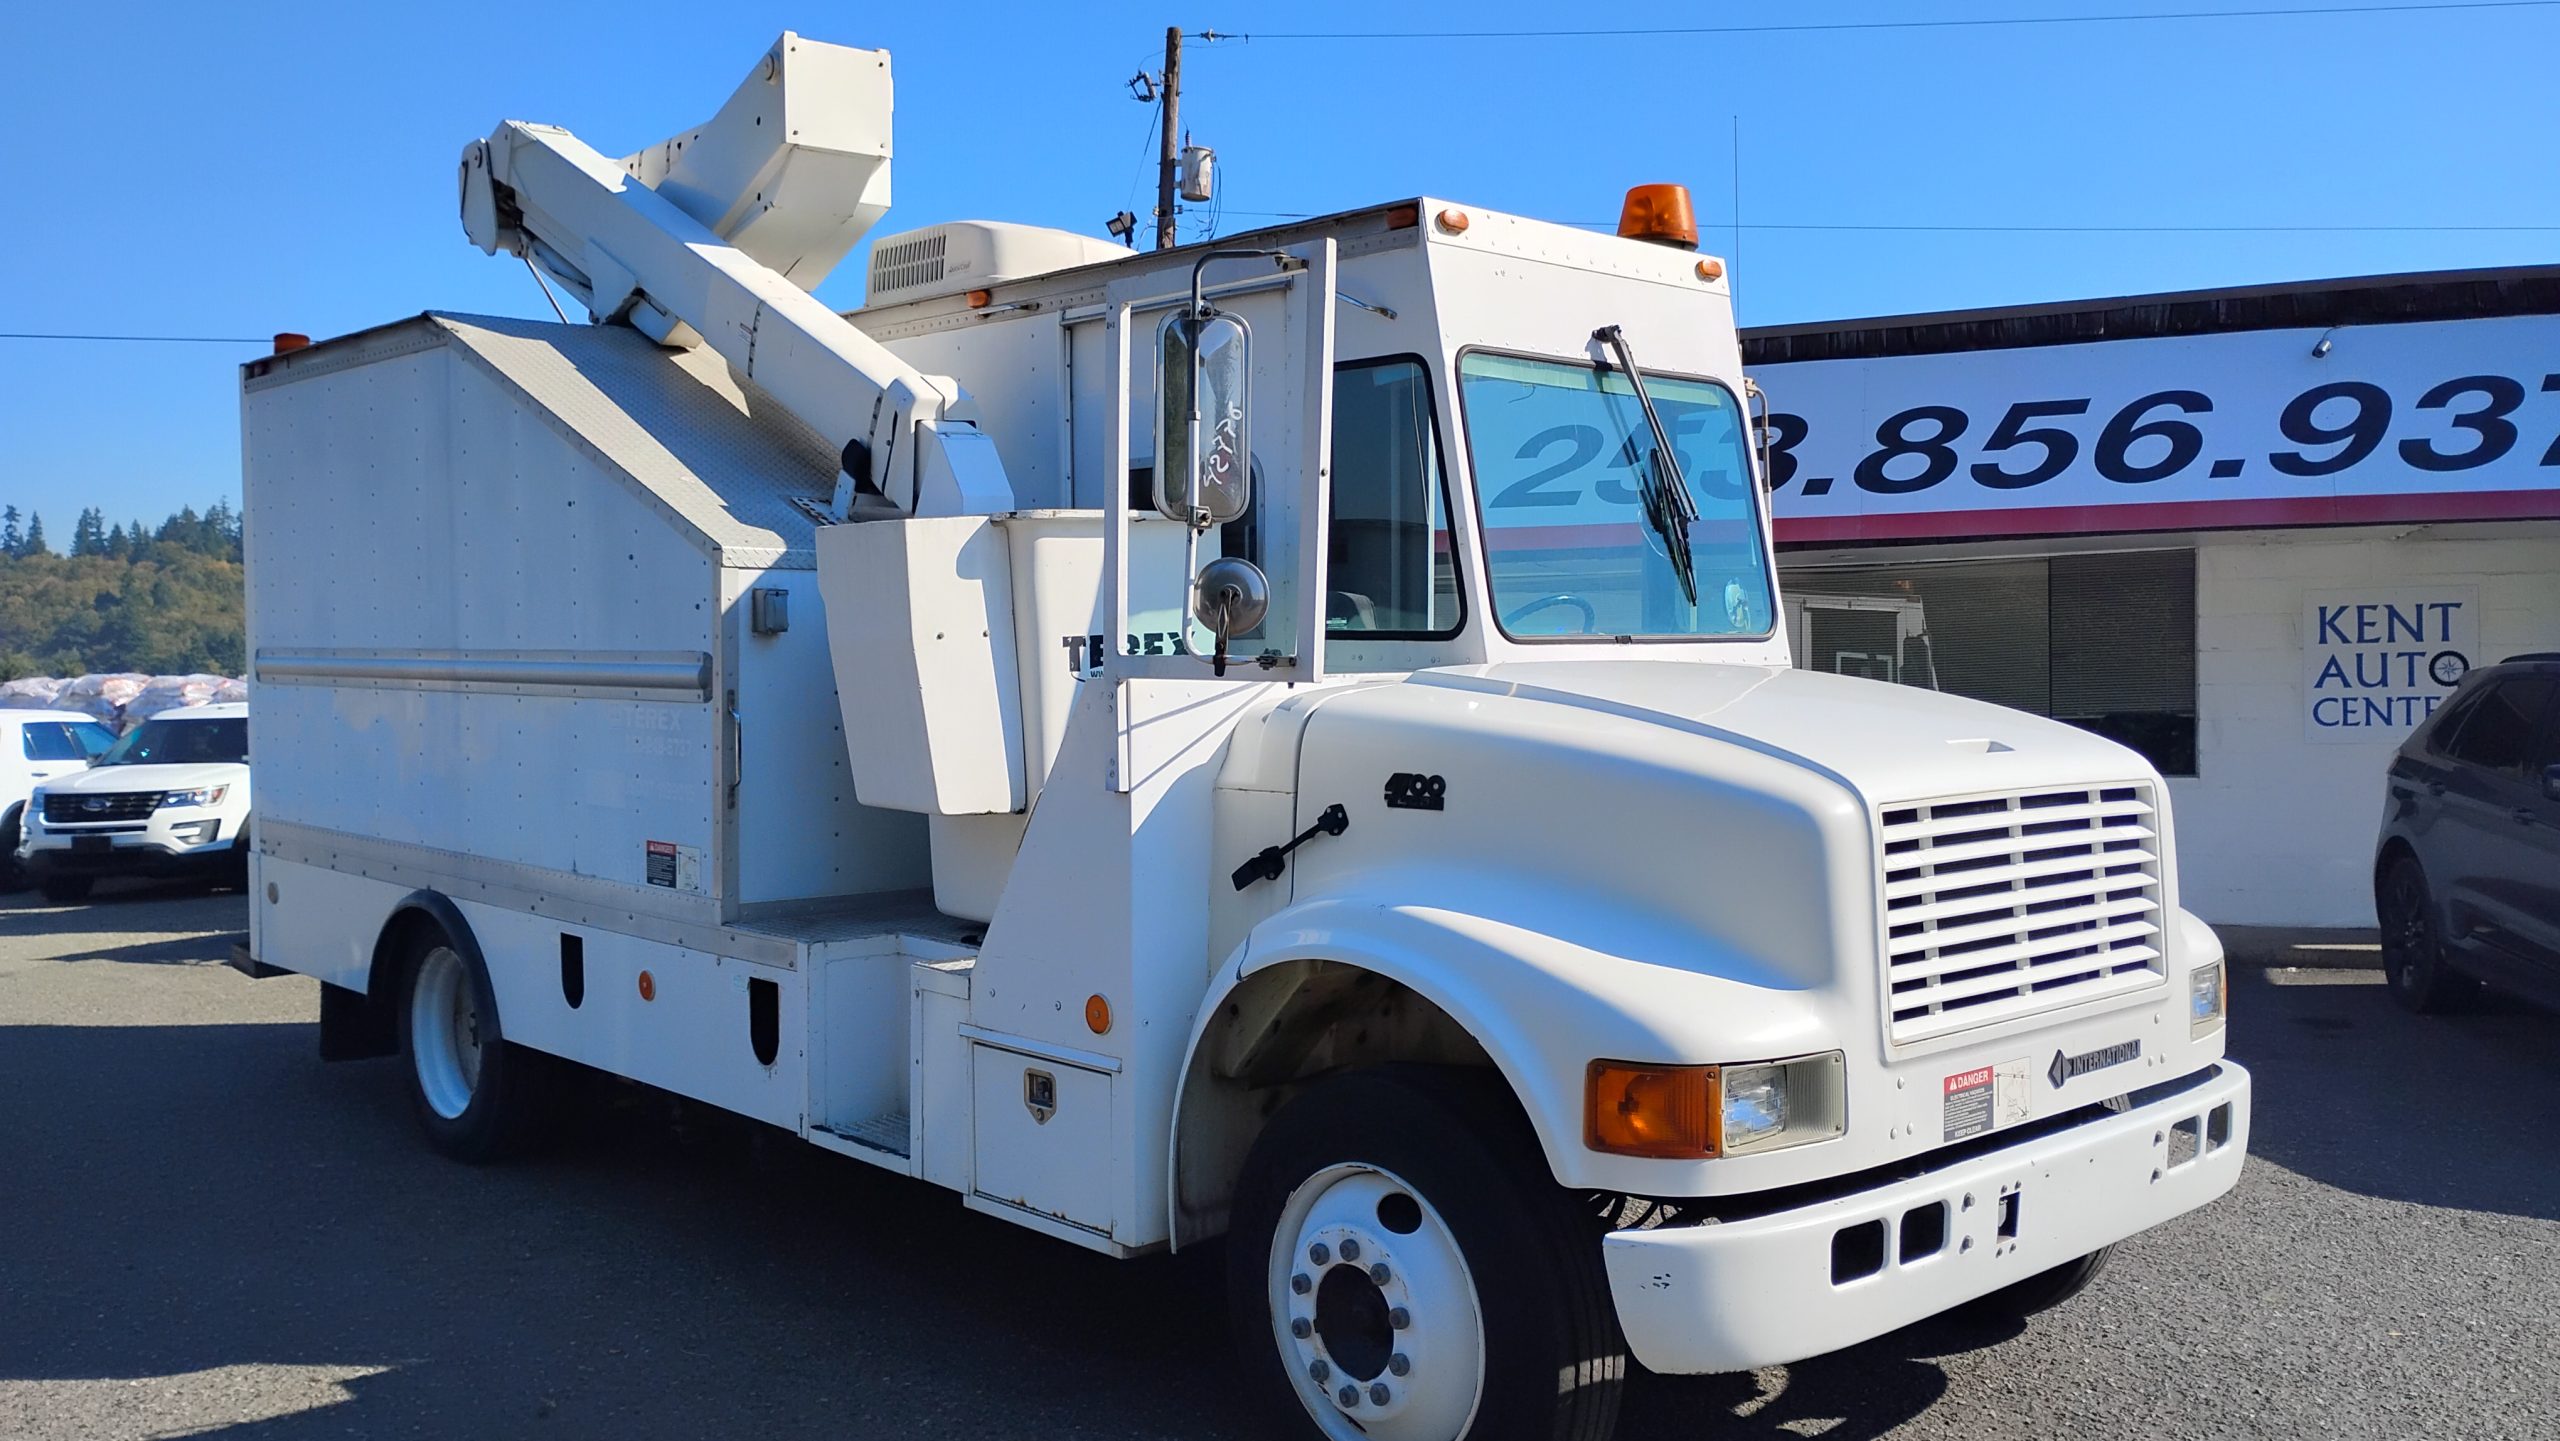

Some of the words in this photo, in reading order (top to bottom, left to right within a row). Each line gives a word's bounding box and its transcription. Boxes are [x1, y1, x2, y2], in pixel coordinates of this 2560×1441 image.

[1489, 372, 2560, 508] 253.856.93
[2317, 602, 2463, 645] KENT
[2314, 650, 2470, 688] AUTO
[2312, 696, 2442, 727] CENTE
[1957, 1071, 1989, 1088] DANGER
